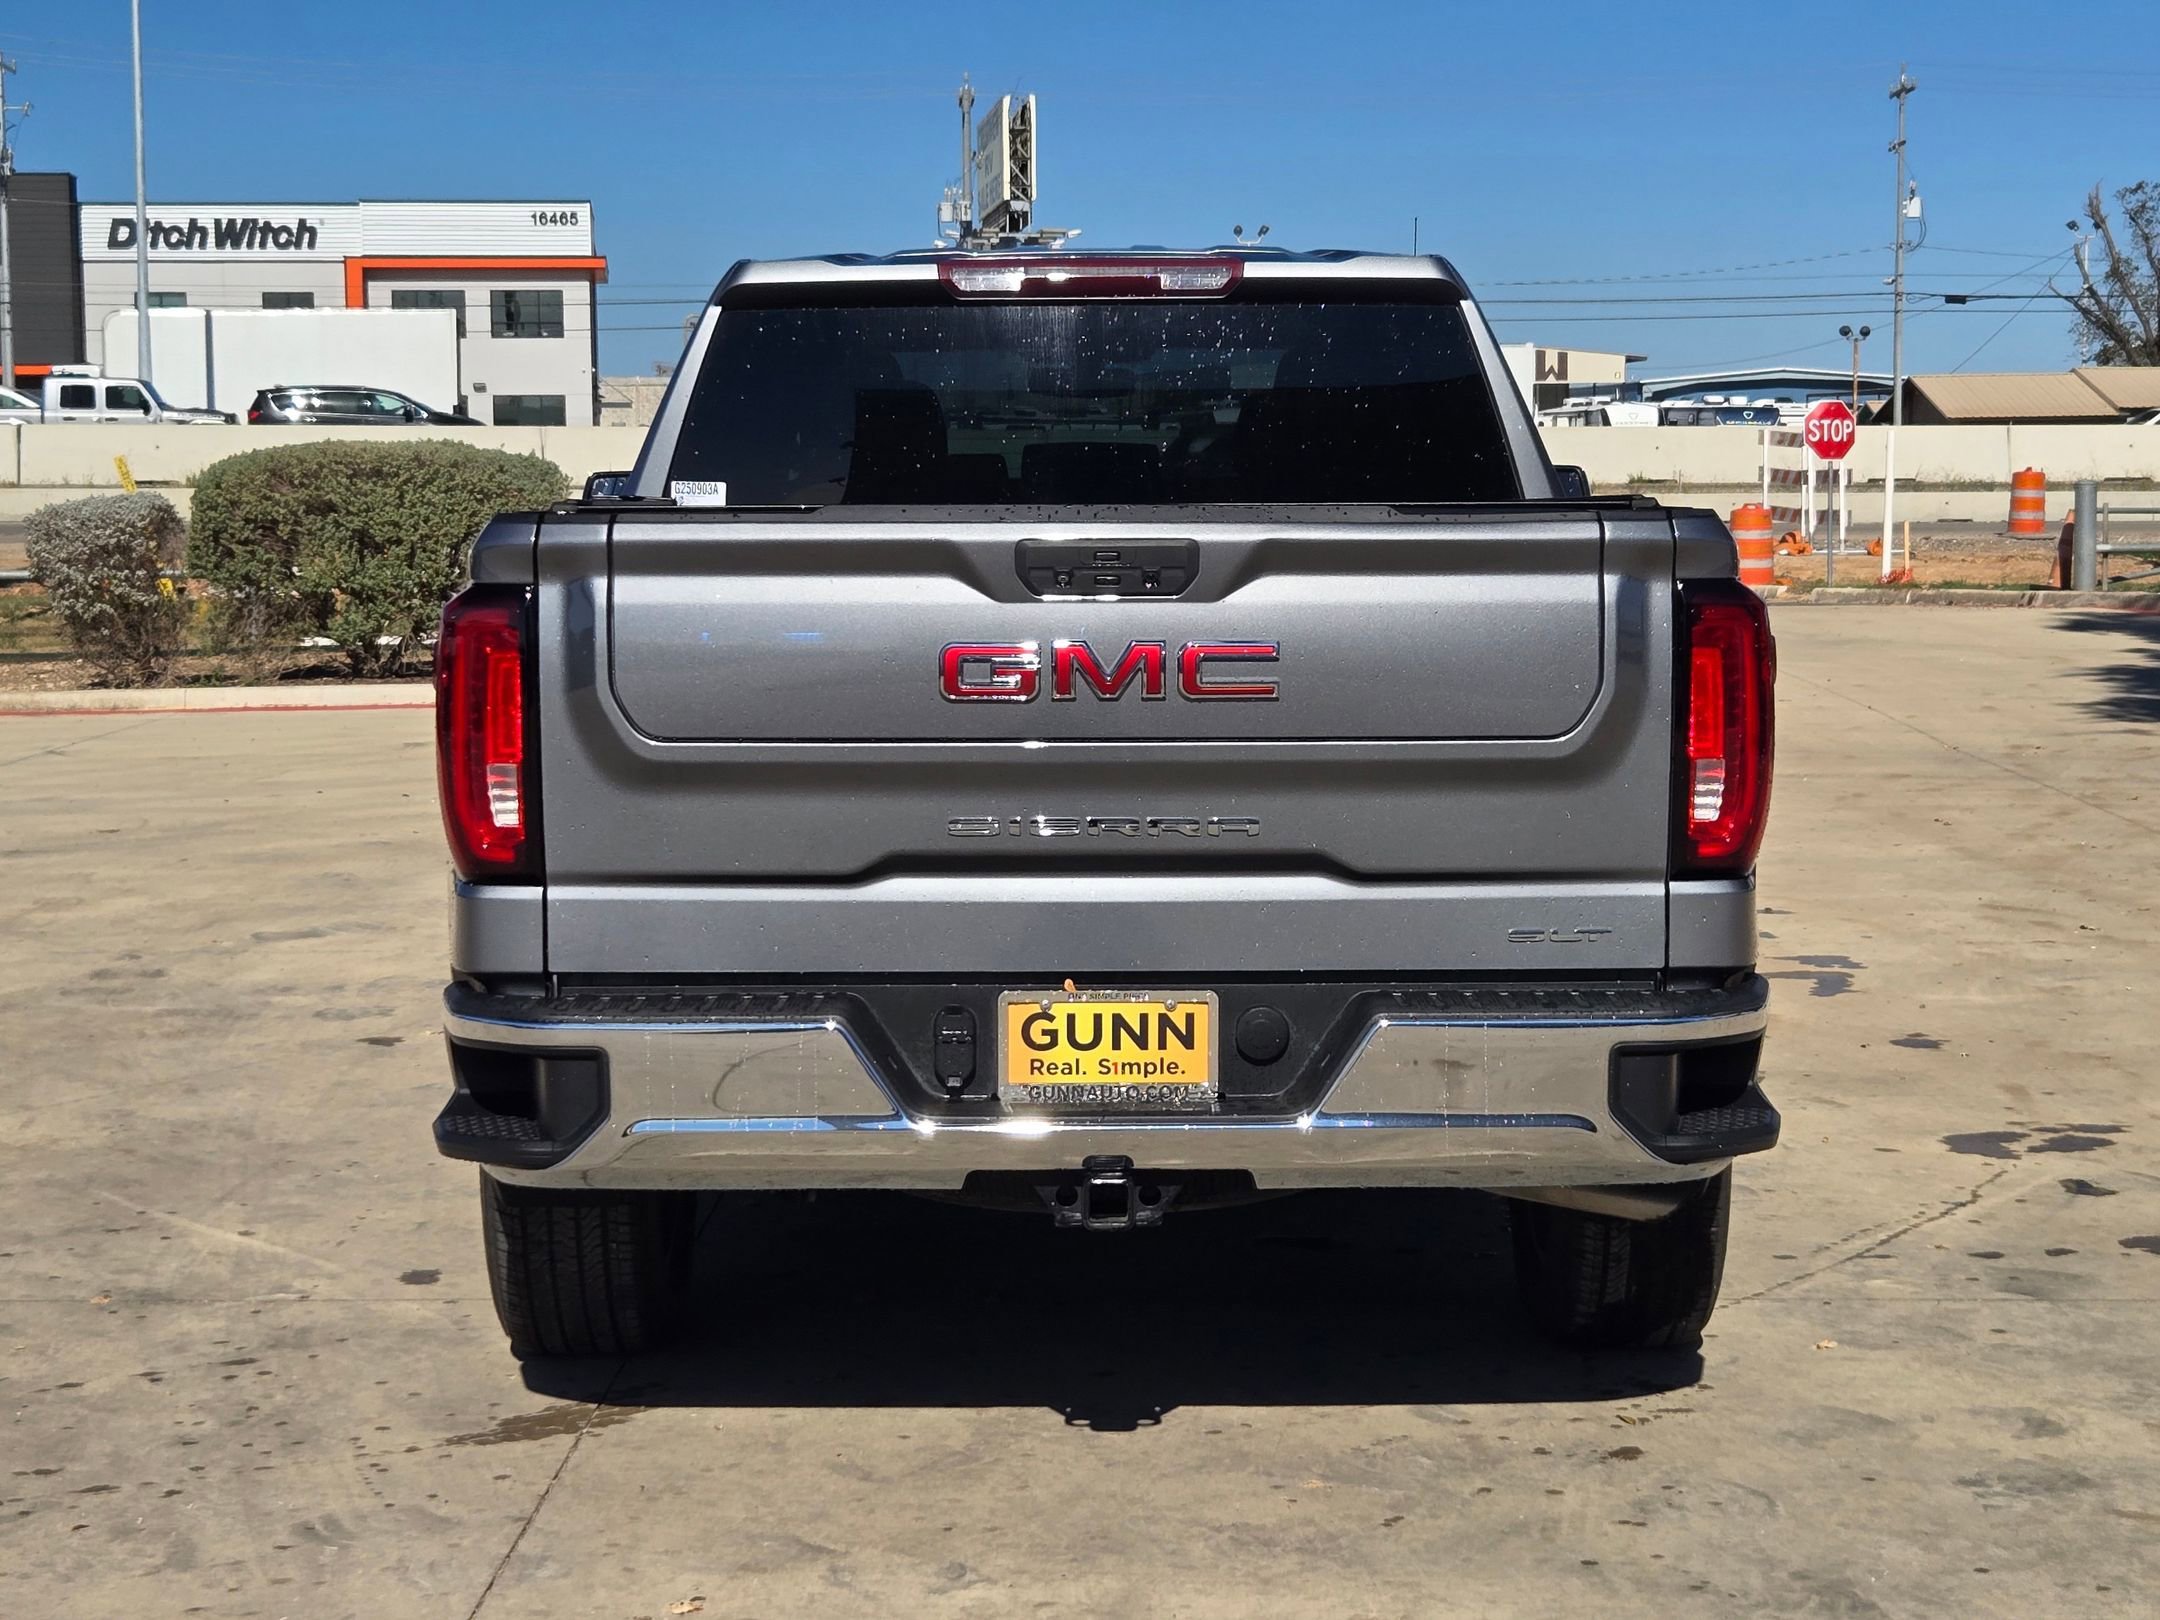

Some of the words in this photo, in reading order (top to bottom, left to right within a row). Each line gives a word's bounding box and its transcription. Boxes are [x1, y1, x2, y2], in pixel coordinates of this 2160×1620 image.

[531, 211, 579, 226] 16465
[107, 218, 209, 250] Dtch
[214, 218, 318, 250] Witch
[1808, 419, 1853, 442] STOP
[675, 482, 718, 495] G250903A
[938, 640, 1281, 702] GMC
[947, 815, 1261, 837] SIERRA
[1507, 927, 1612, 943] SLT
[1021, 1012, 1195, 1051] GUNN
[1030, 1058, 1087, 1075] Real.
